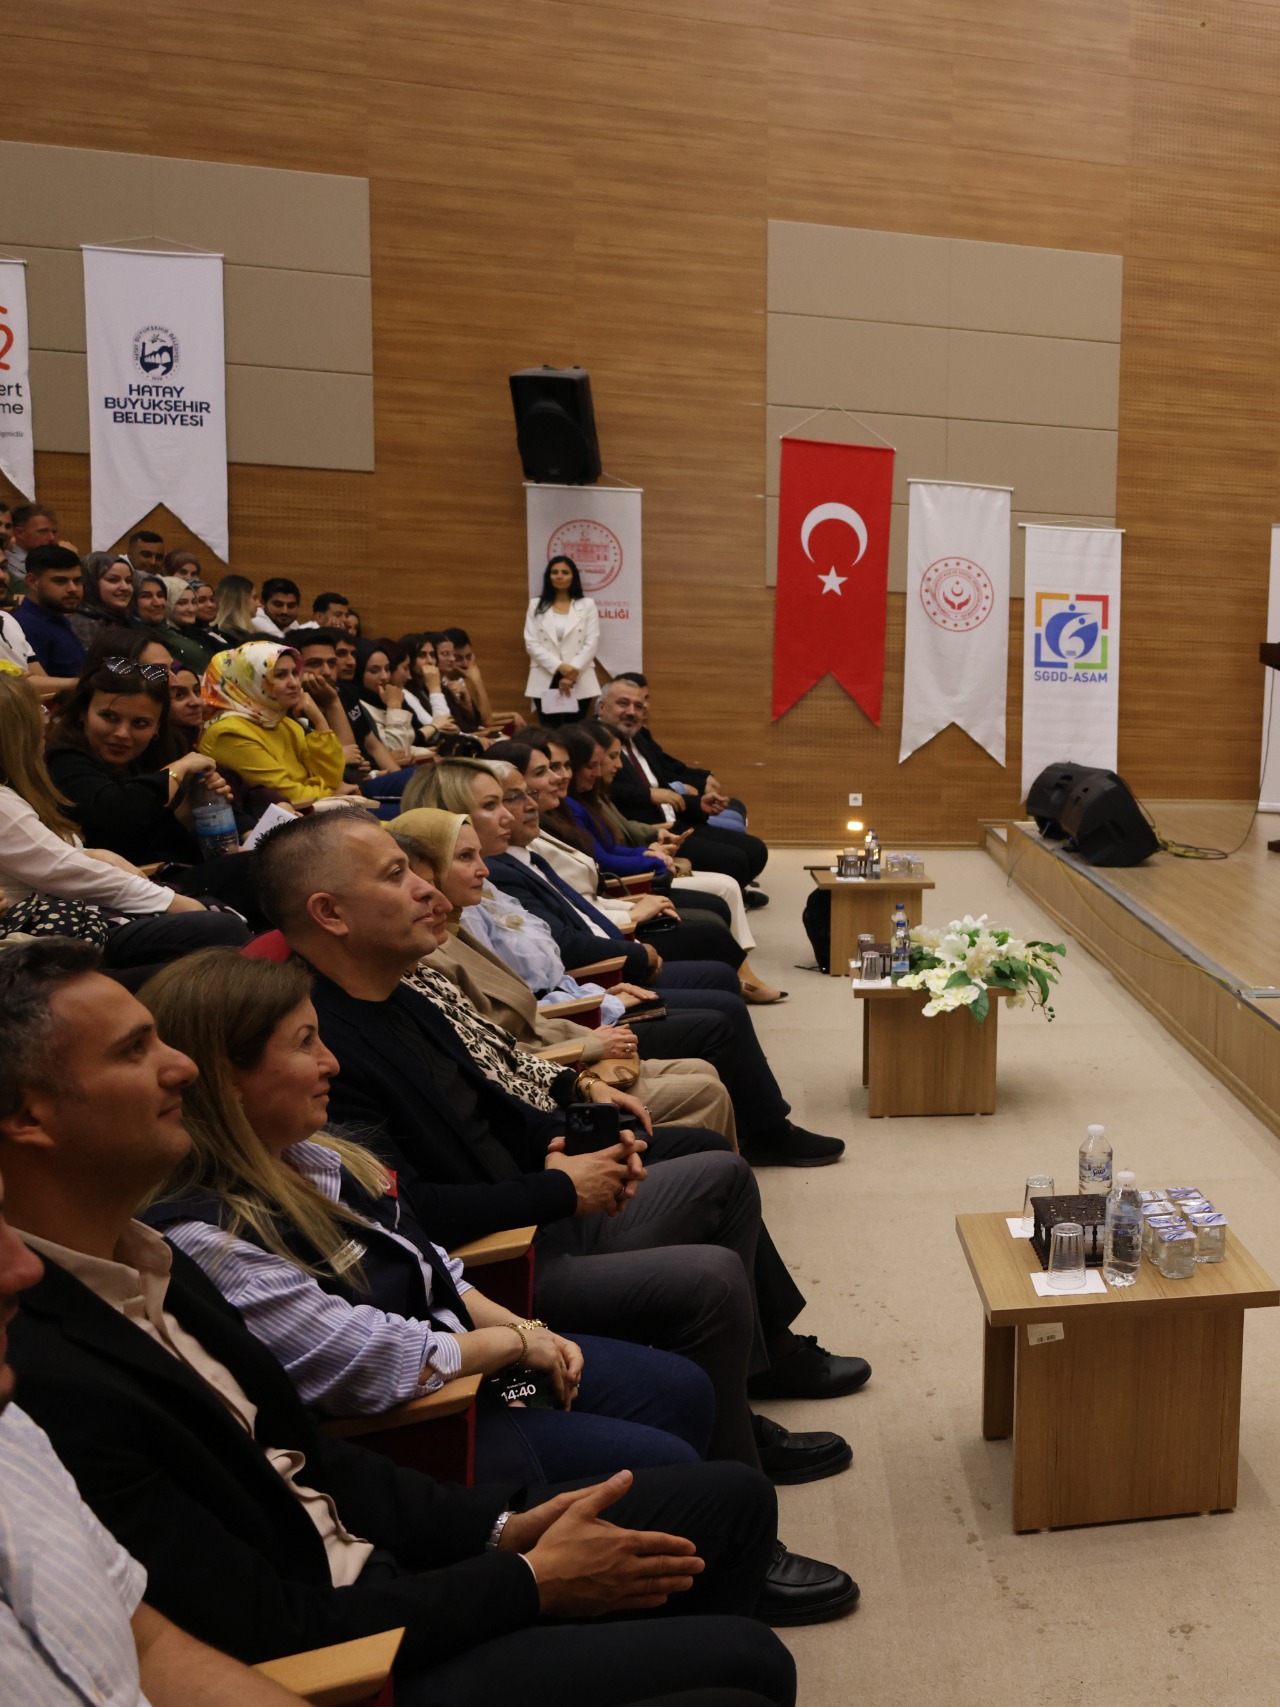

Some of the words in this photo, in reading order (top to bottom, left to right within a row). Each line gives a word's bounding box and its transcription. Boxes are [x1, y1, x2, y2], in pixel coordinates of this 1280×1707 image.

[128, 384, 185, 398] HATAY
[104, 397, 211, 414] BÜYÜKŞEHİR
[113, 411, 204, 427] BELEDİYESİ
[598, 607, 629, 620] LİLİĞİ
[1034, 670, 1108, 683] SGDD-ASAM
[501, 1384, 537, 1402] 14:40
